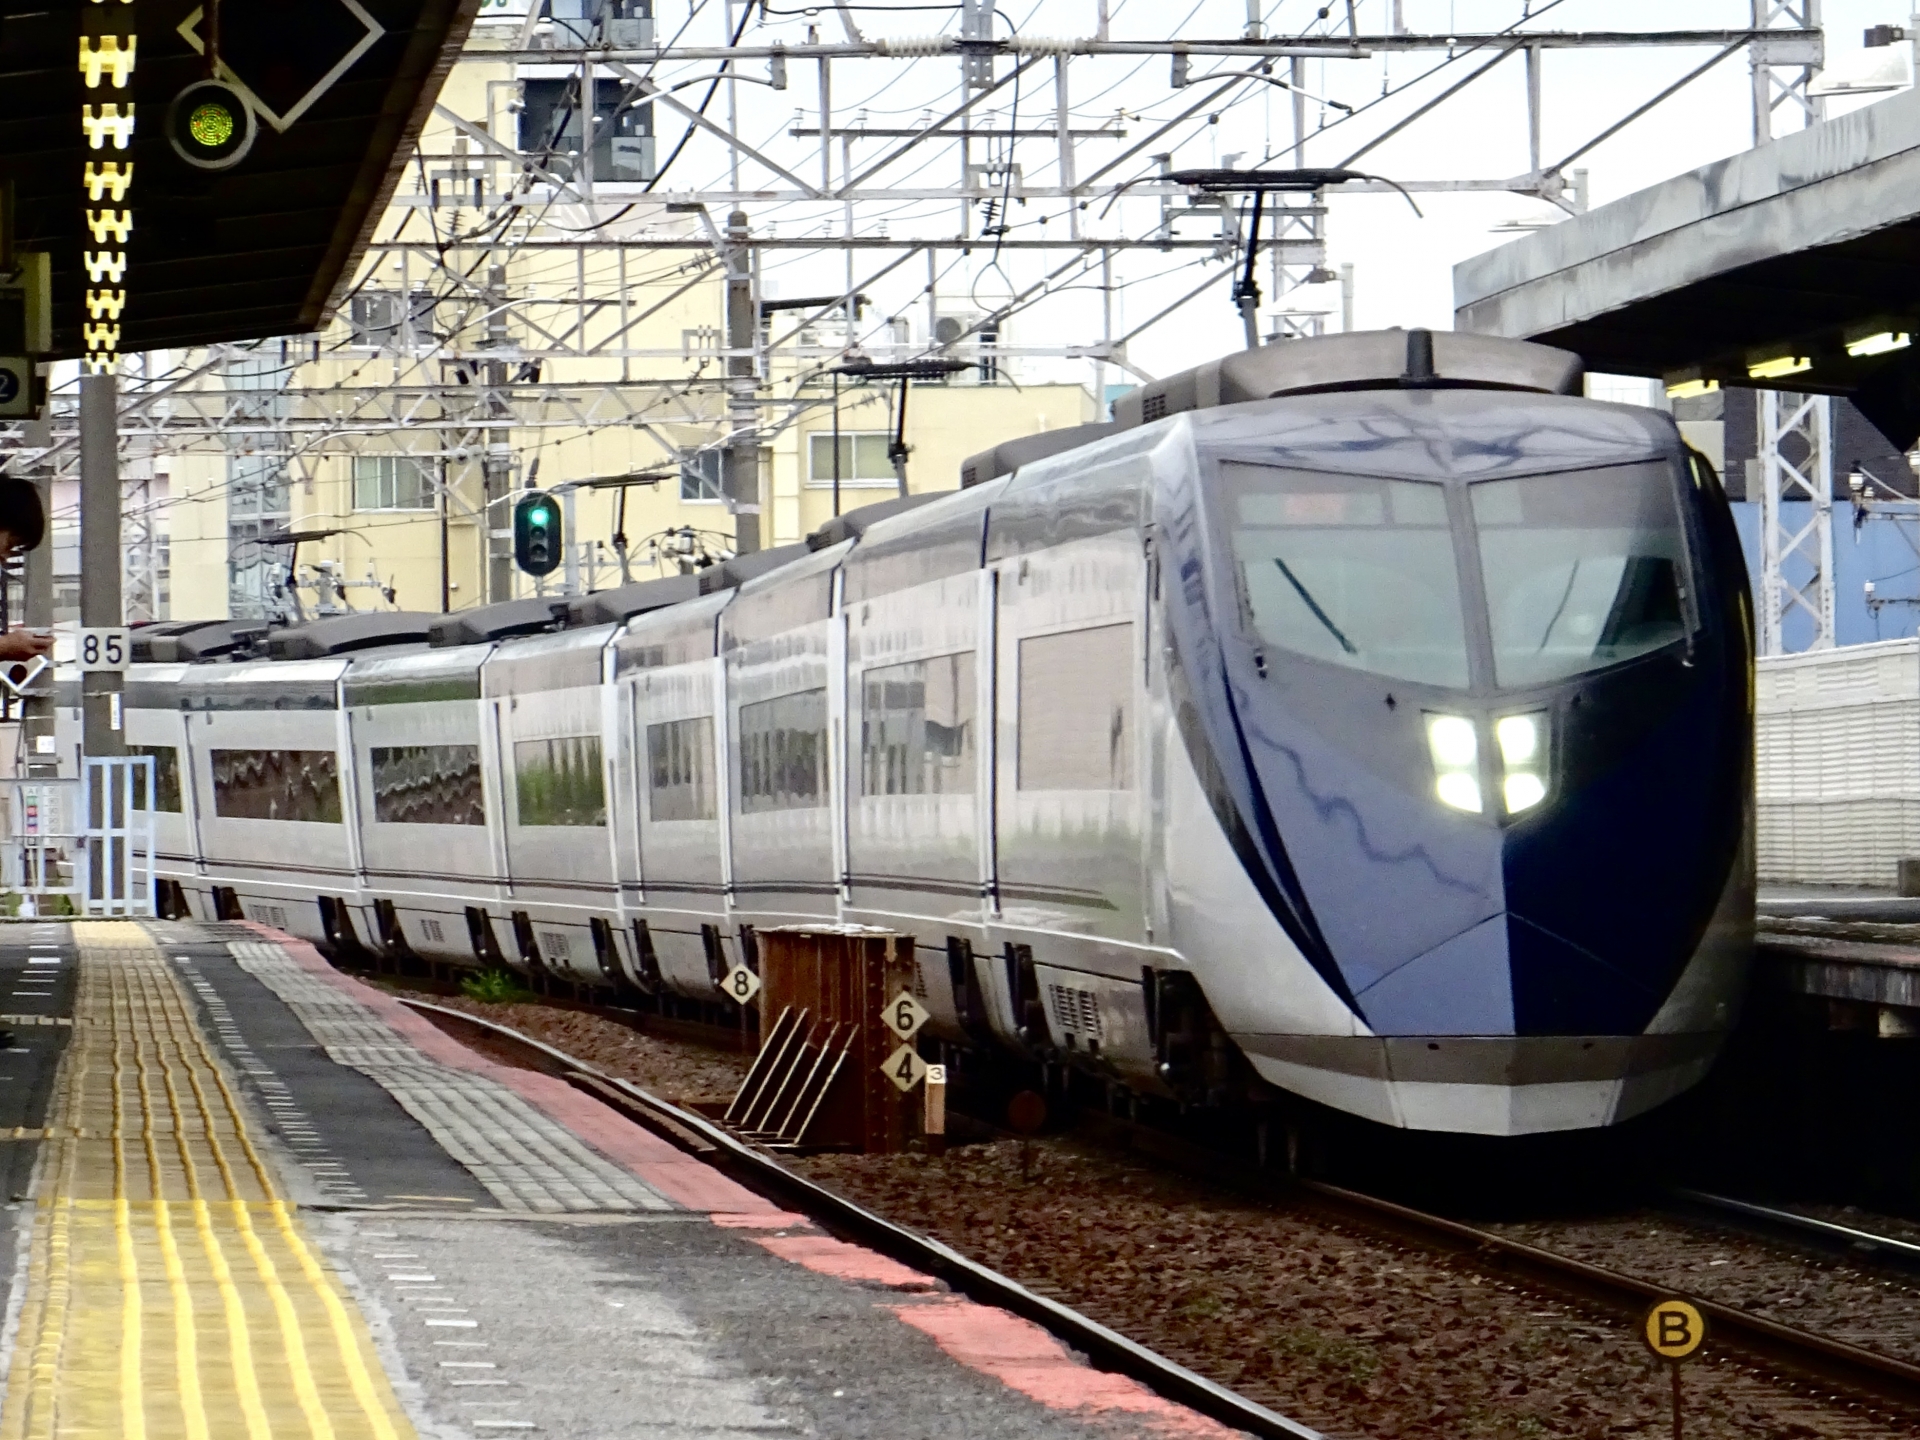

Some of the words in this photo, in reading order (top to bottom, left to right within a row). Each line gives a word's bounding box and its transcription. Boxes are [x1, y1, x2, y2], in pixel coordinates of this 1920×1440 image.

[83, 634, 122, 664] 85
[733, 970, 749, 996] 8
[895, 1000, 914, 1031] 6
[895, 1052, 914, 1084] 4
[929, 1067, 943, 1081] 3
[1658, 1311, 1692, 1347] B
